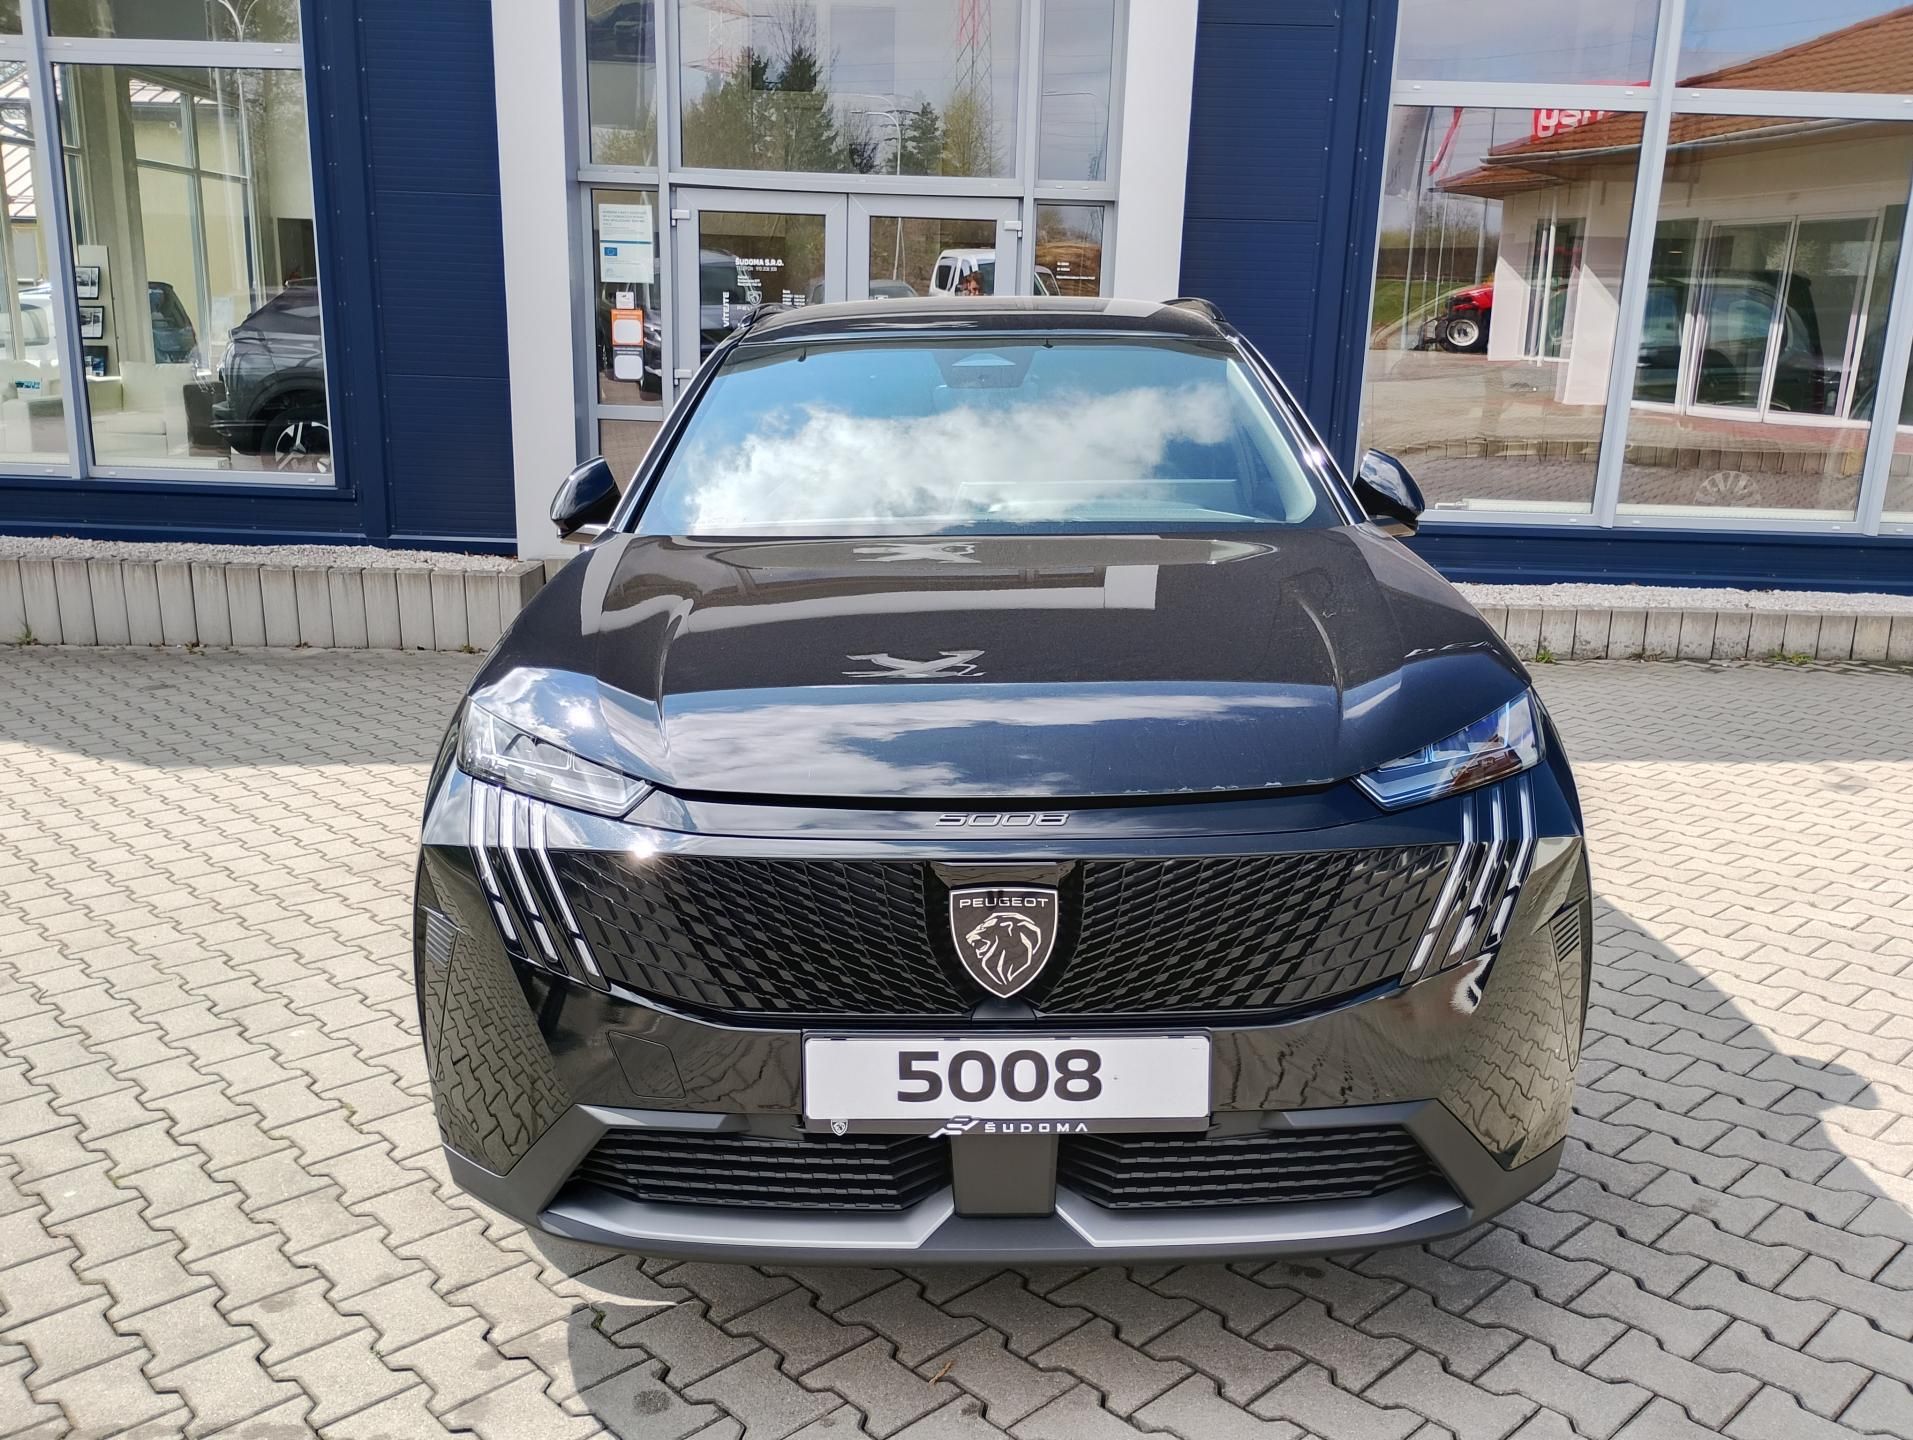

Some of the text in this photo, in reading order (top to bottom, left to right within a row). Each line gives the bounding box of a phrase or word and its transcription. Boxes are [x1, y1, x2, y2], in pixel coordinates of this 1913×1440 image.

[735, 257, 785, 267] ŠUDOMA S.R.O.
[935, 812, 1070, 827] 5008
[959, 897, 1049, 909] PEUGEOT
[897, 1049, 1103, 1103] 5008
[984, 1121, 1089, 1133] ŠUDOMA
